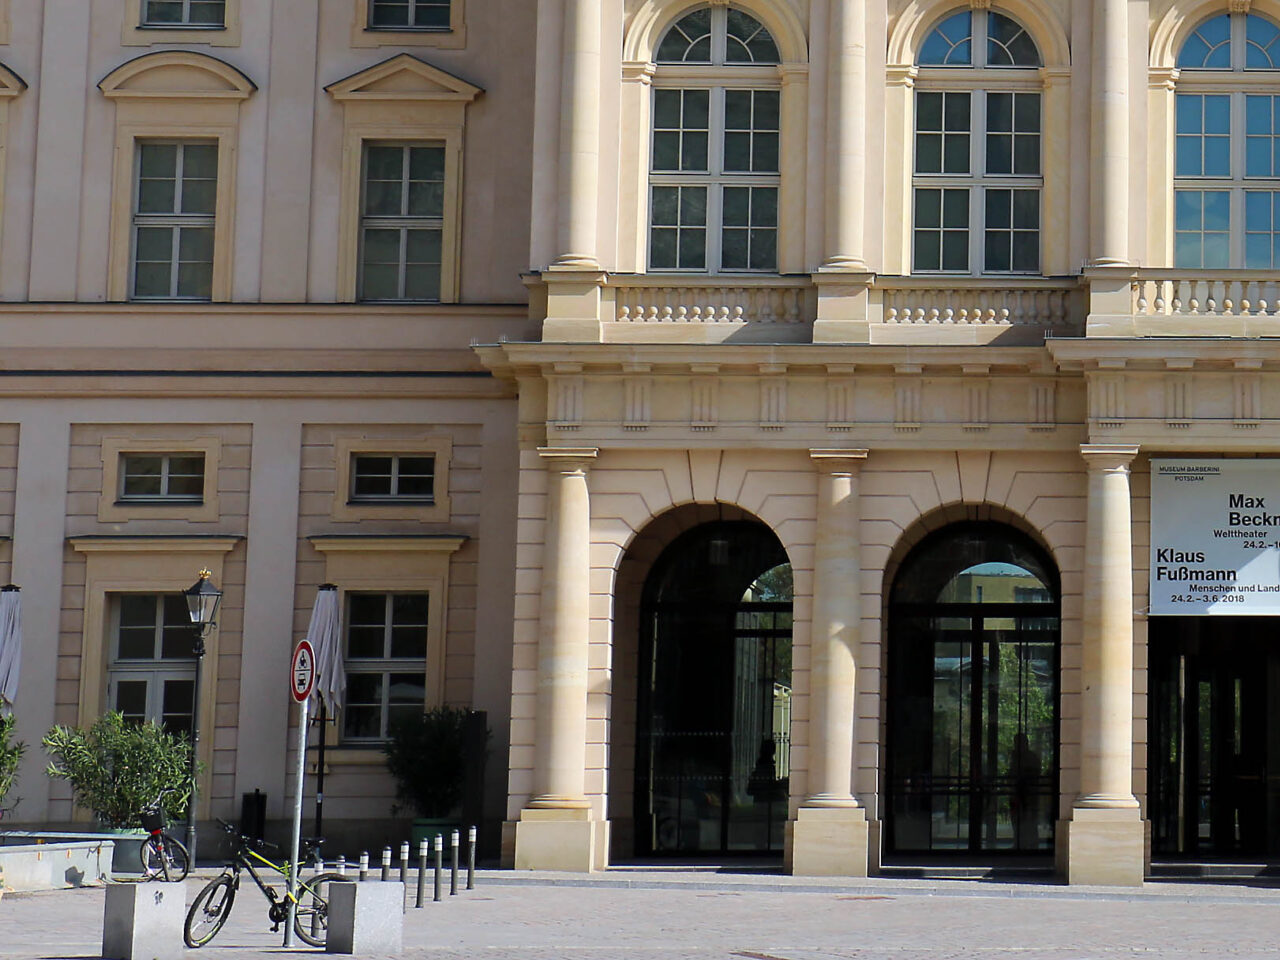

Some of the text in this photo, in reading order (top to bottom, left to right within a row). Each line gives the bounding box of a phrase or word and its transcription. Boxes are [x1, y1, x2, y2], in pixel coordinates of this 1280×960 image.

[1229, 494, 1265, 508] Max
[1213, 530, 1268, 538] Welttheater
[1156, 548, 1205, 563] Klaus
[1156, 567, 1237, 581] Fußmann
[1189, 584, 1236, 592] Menschen
[1238, 584, 1256, 592] und
